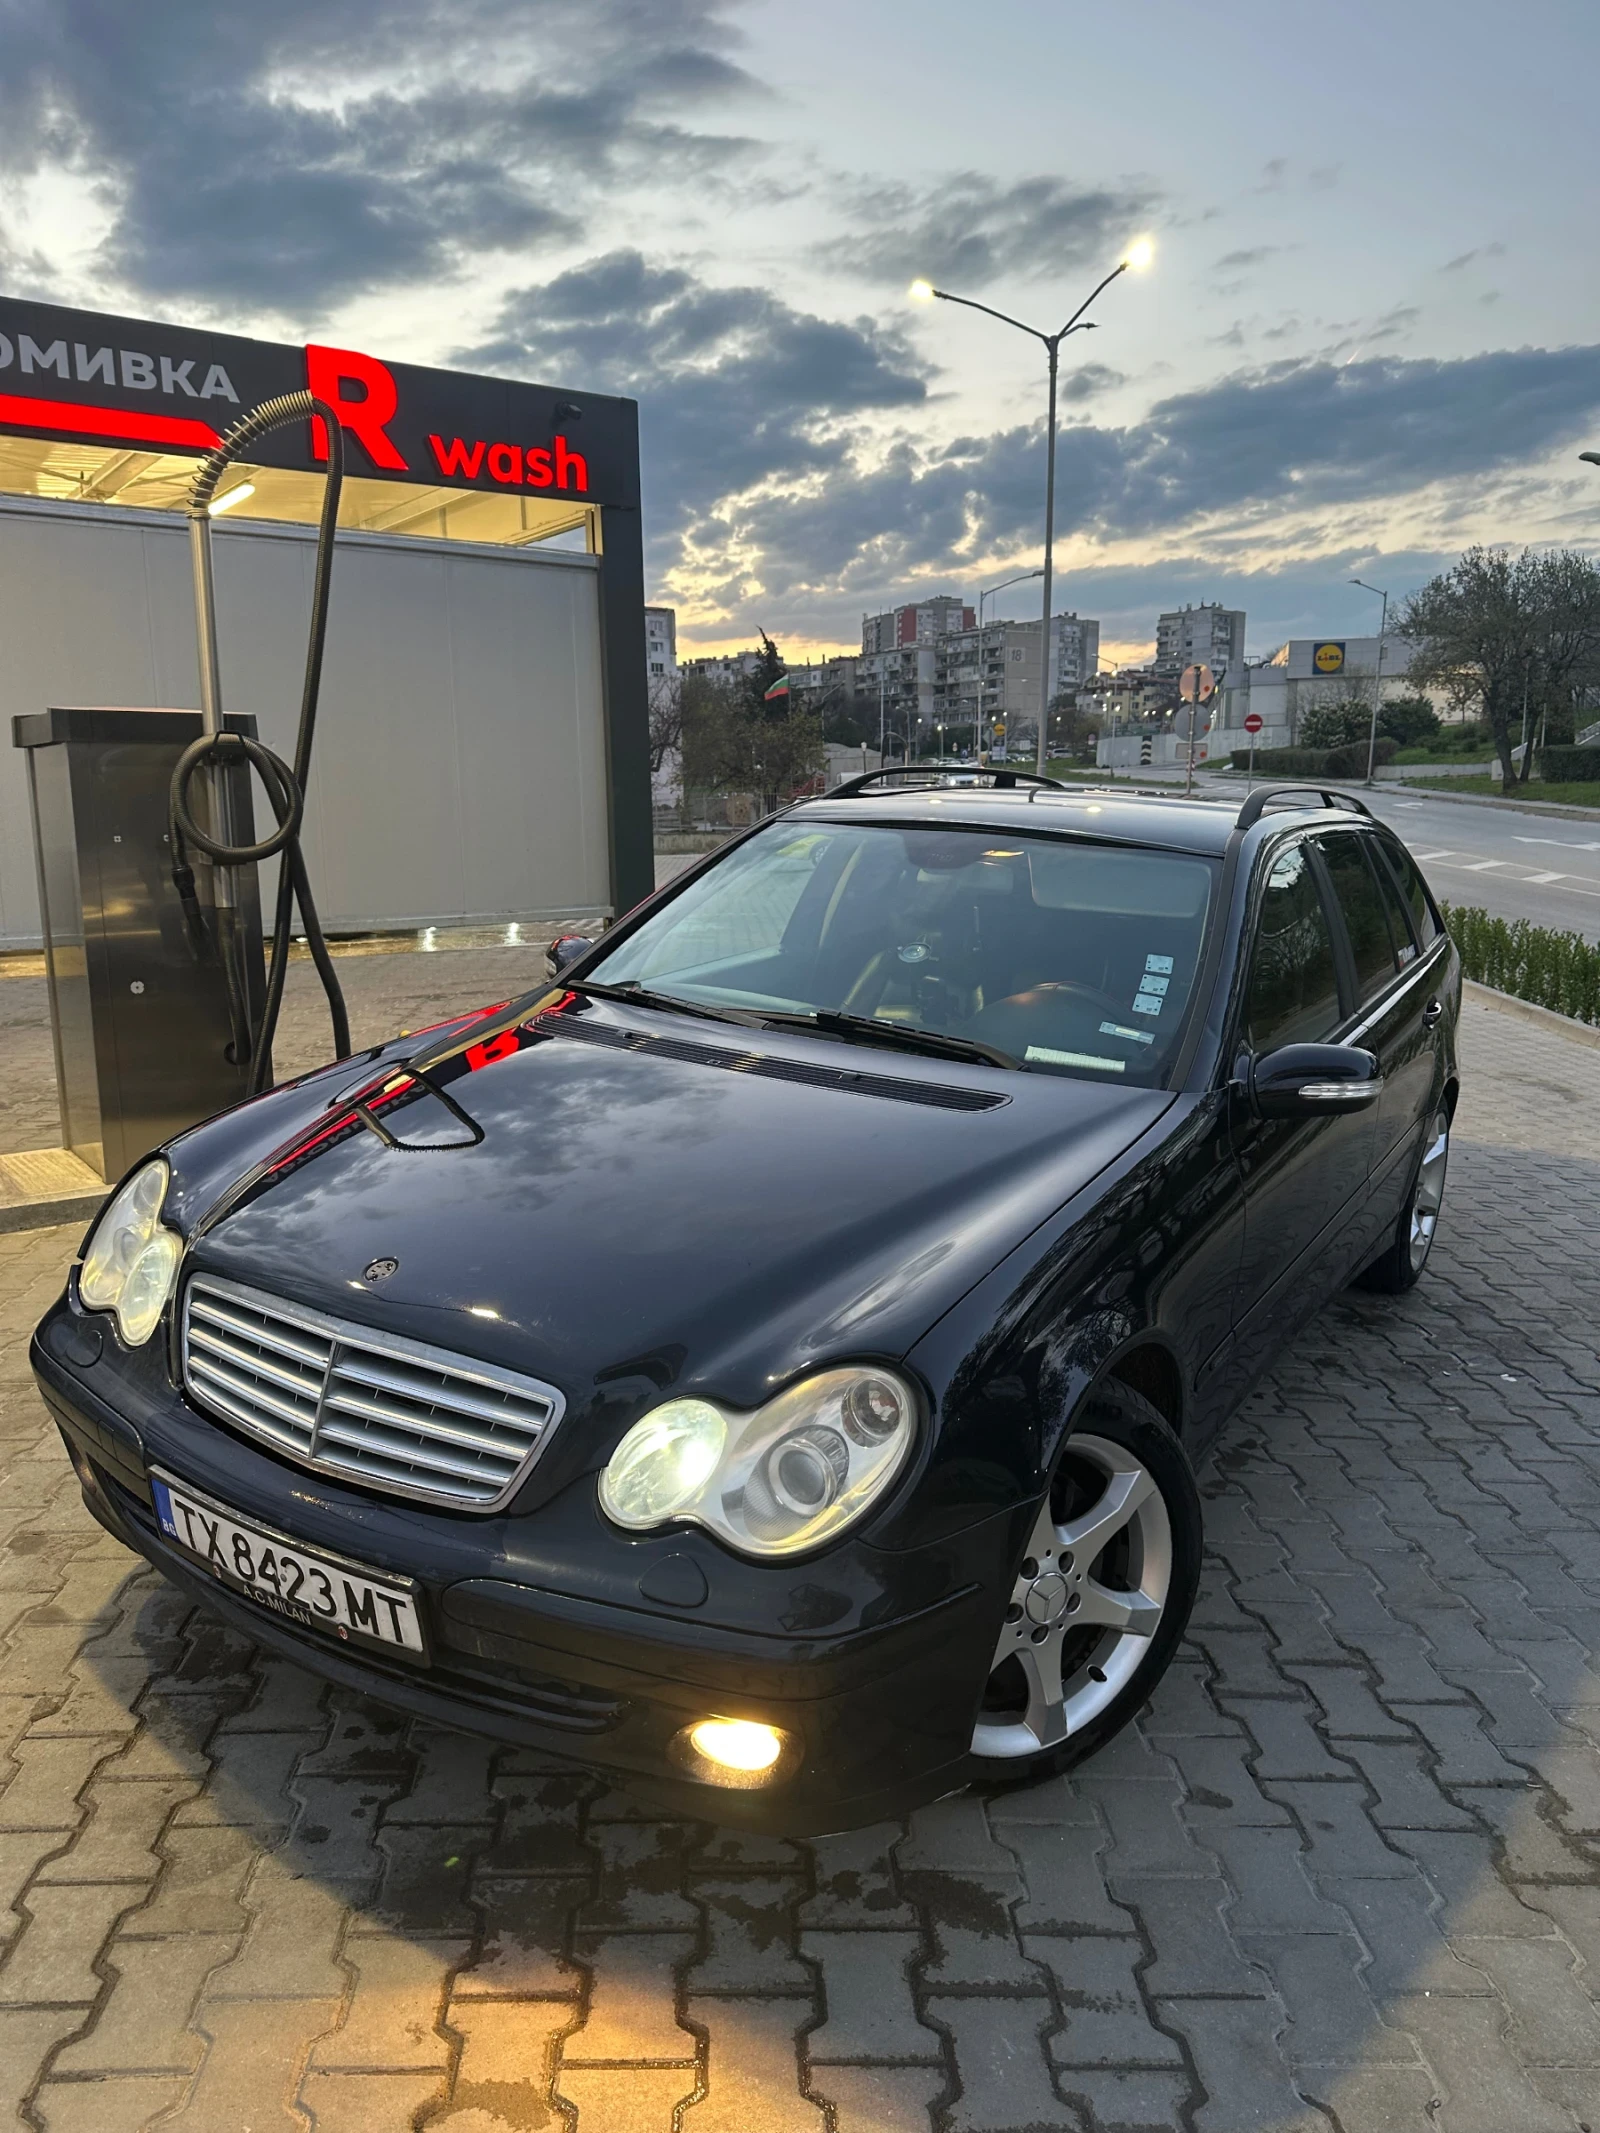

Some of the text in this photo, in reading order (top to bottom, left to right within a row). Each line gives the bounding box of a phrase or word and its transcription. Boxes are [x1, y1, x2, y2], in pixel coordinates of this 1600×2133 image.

[305, 344, 588, 492] R wash
[1011, 649, 1022, 662] 18
[162, 1518, 177, 1536] BG
